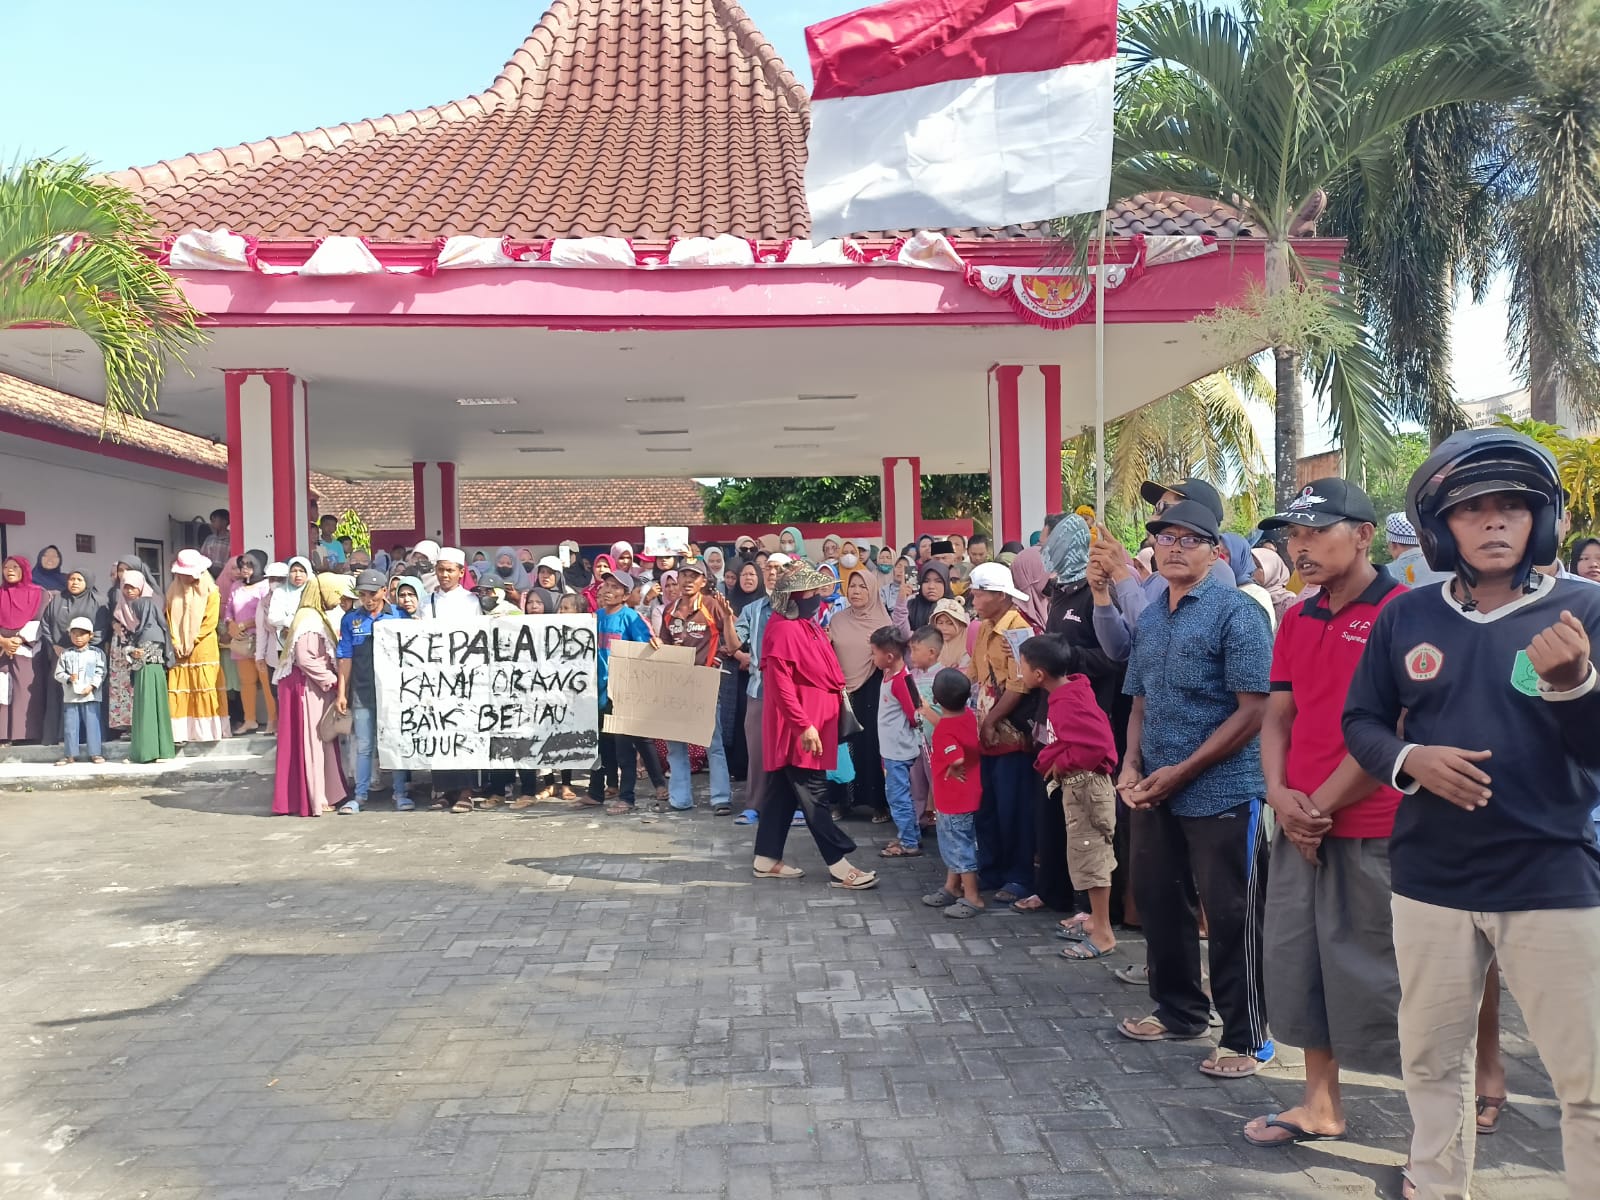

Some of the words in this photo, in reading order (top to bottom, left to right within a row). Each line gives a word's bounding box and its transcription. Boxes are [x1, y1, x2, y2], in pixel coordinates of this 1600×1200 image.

[397, 625, 537, 667] KEPALA
[545, 625, 596, 662] DESA
[400, 667, 479, 702] KAMI
[492, 667, 588, 697] ORANG
[401, 704, 465, 734] BAIK
[402, 731, 474, 758] JUJUR
